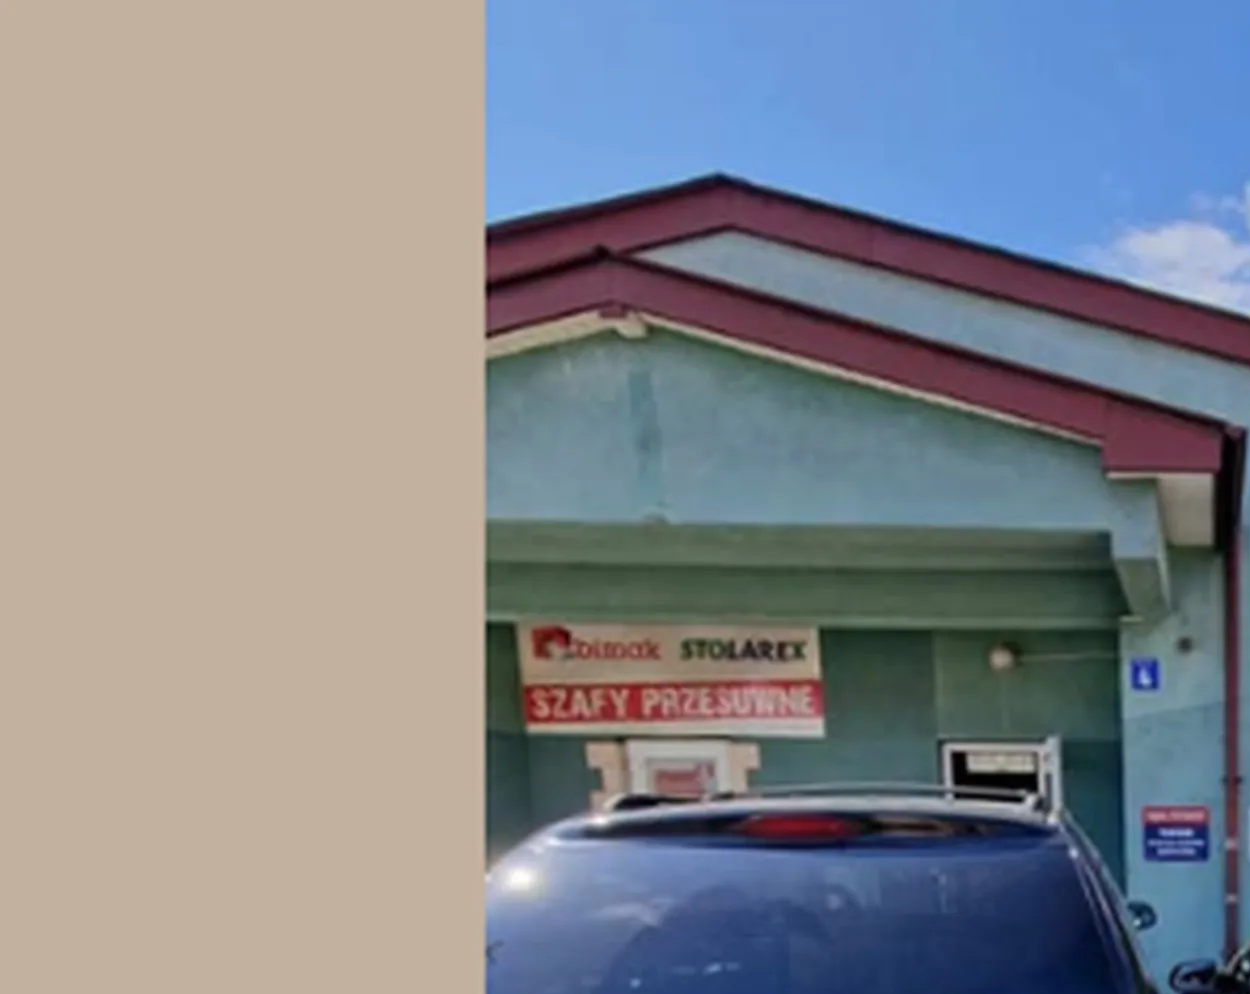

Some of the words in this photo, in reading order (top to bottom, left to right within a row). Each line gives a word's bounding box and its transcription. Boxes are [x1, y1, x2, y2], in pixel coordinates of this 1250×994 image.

[680, 637, 808, 662] STOLAREX
[531, 685, 632, 719] SZAFY
[642, 685, 815, 717] PRZESUWNE
